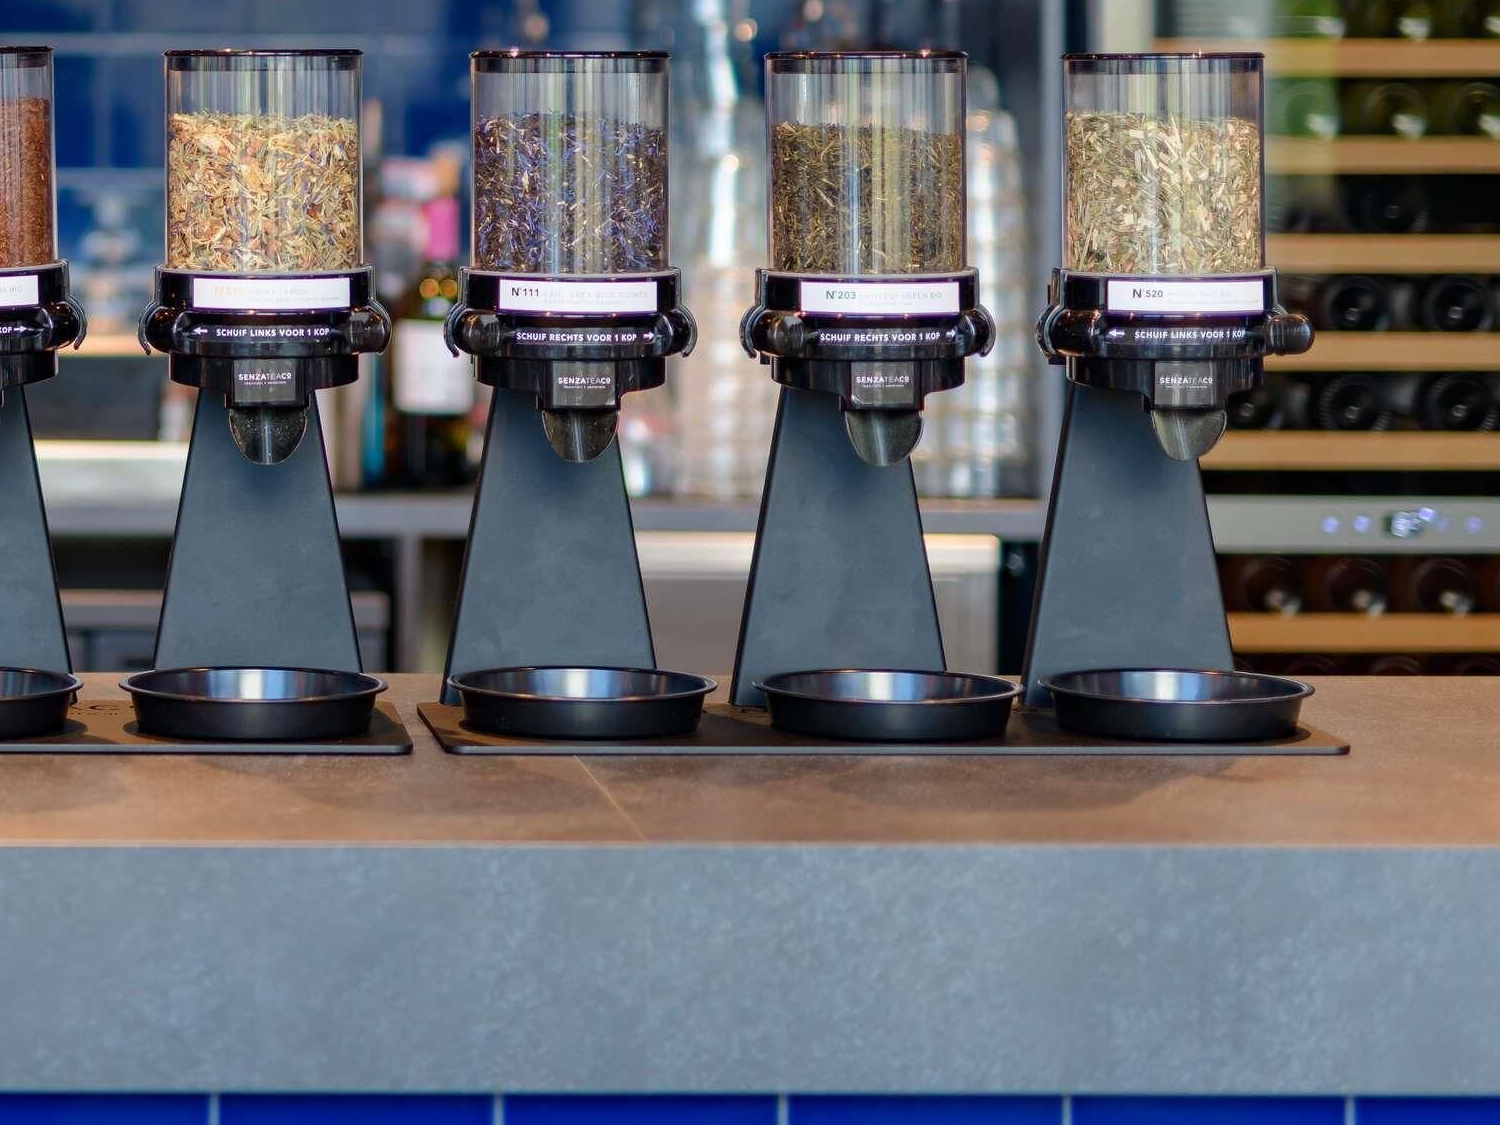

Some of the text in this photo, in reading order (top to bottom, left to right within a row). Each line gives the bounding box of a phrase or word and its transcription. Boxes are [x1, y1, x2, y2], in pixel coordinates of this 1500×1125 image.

[216, 328, 247, 337] SCHUIF
[250, 329, 277, 337] LINKS
[279, 328, 305, 337] VOOR
[313, 328, 330, 336] KOP
[516, 332, 547, 341] SCHUIF
[549, 333, 584, 342] RECHTS
[586, 333, 612, 342] VOOR
[621, 333, 637, 341] KOP
[820, 332, 852, 341] SCHUIF
[854, 333, 889, 342] RECHTS
[891, 333, 917, 341] VOOR
[925, 331, 940, 340] KOP
[1134, 331, 1168, 339] SCHUIF
[1170, 331, 1197, 339] LINKS
[1199, 331, 1224, 339] VOOR
[1232, 330, 1246, 338] KOP
